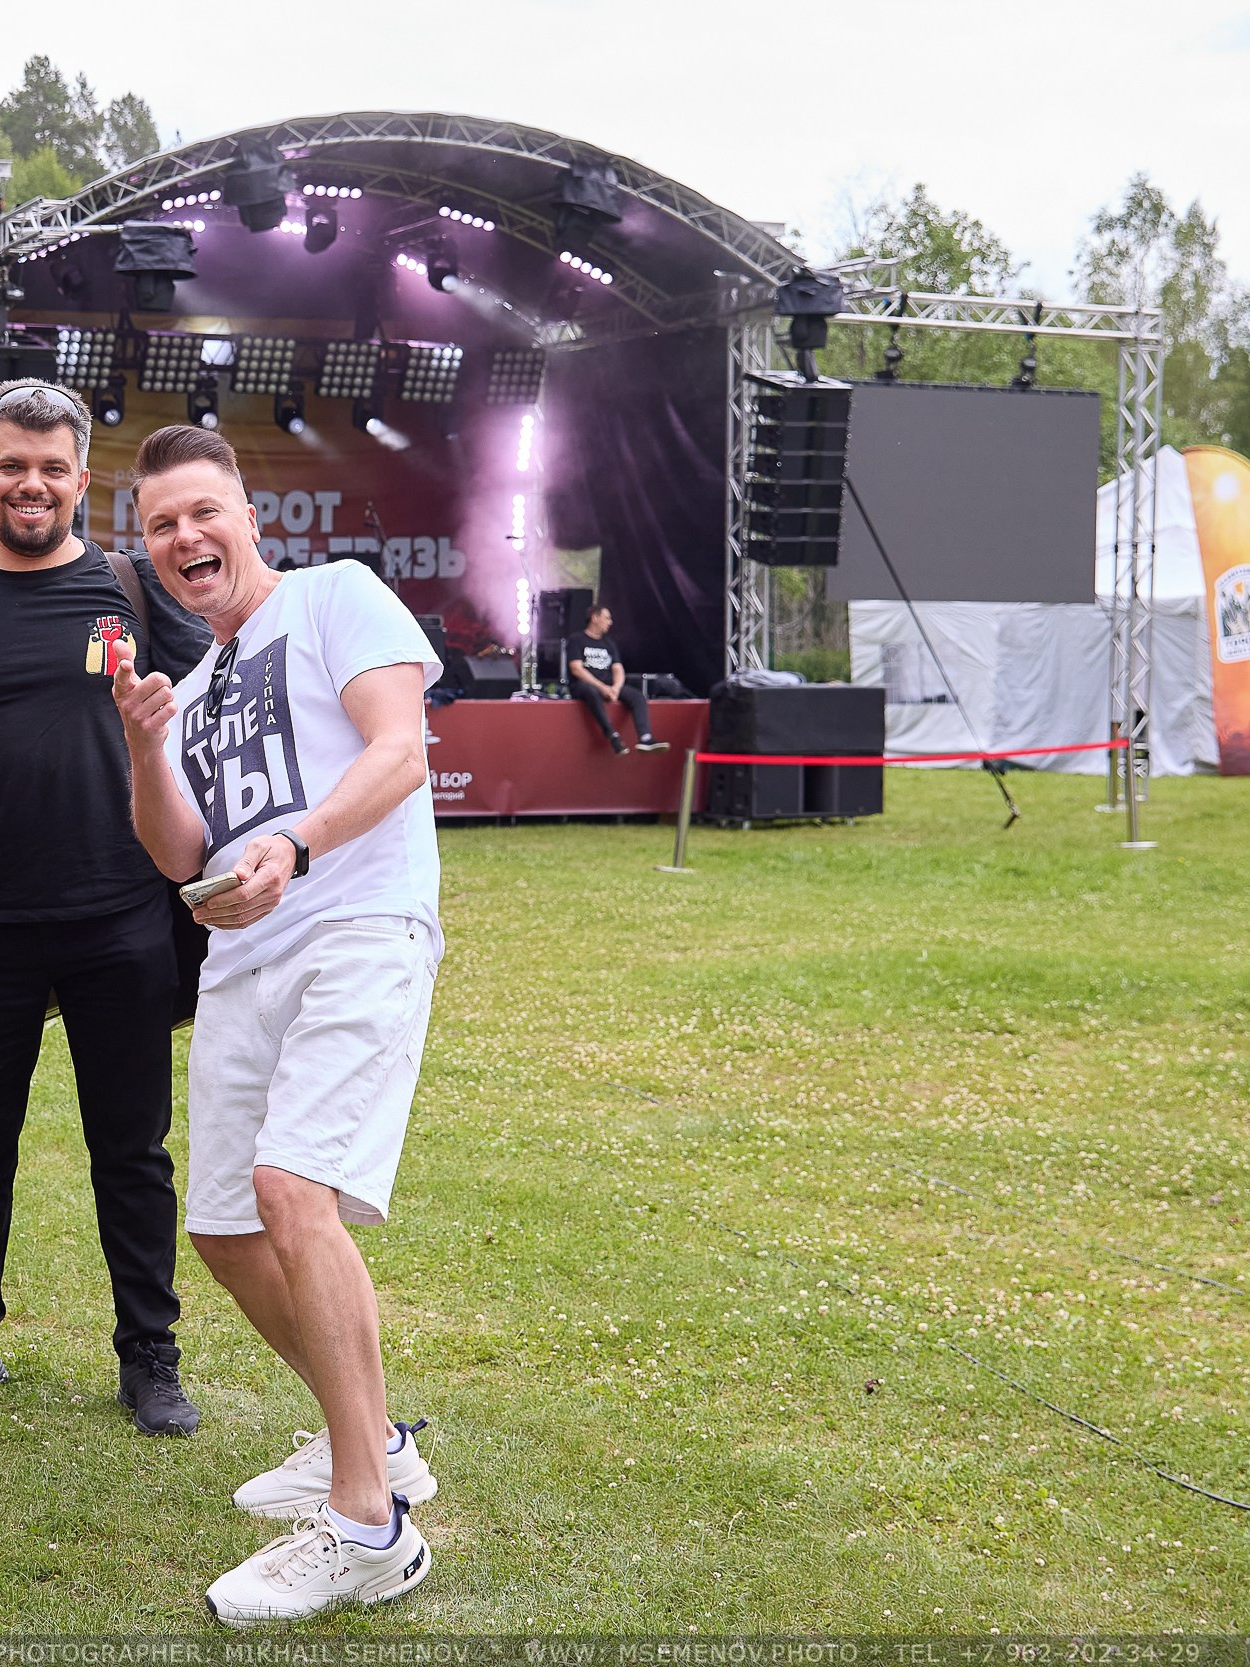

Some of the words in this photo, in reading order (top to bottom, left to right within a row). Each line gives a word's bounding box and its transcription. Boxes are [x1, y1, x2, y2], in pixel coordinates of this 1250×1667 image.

[113, 489, 342, 534] ПРОТ
[185, 673, 242, 741] ПС
[263, 650, 277, 726] ГРУППА
[440, 772, 473, 788] БОР
